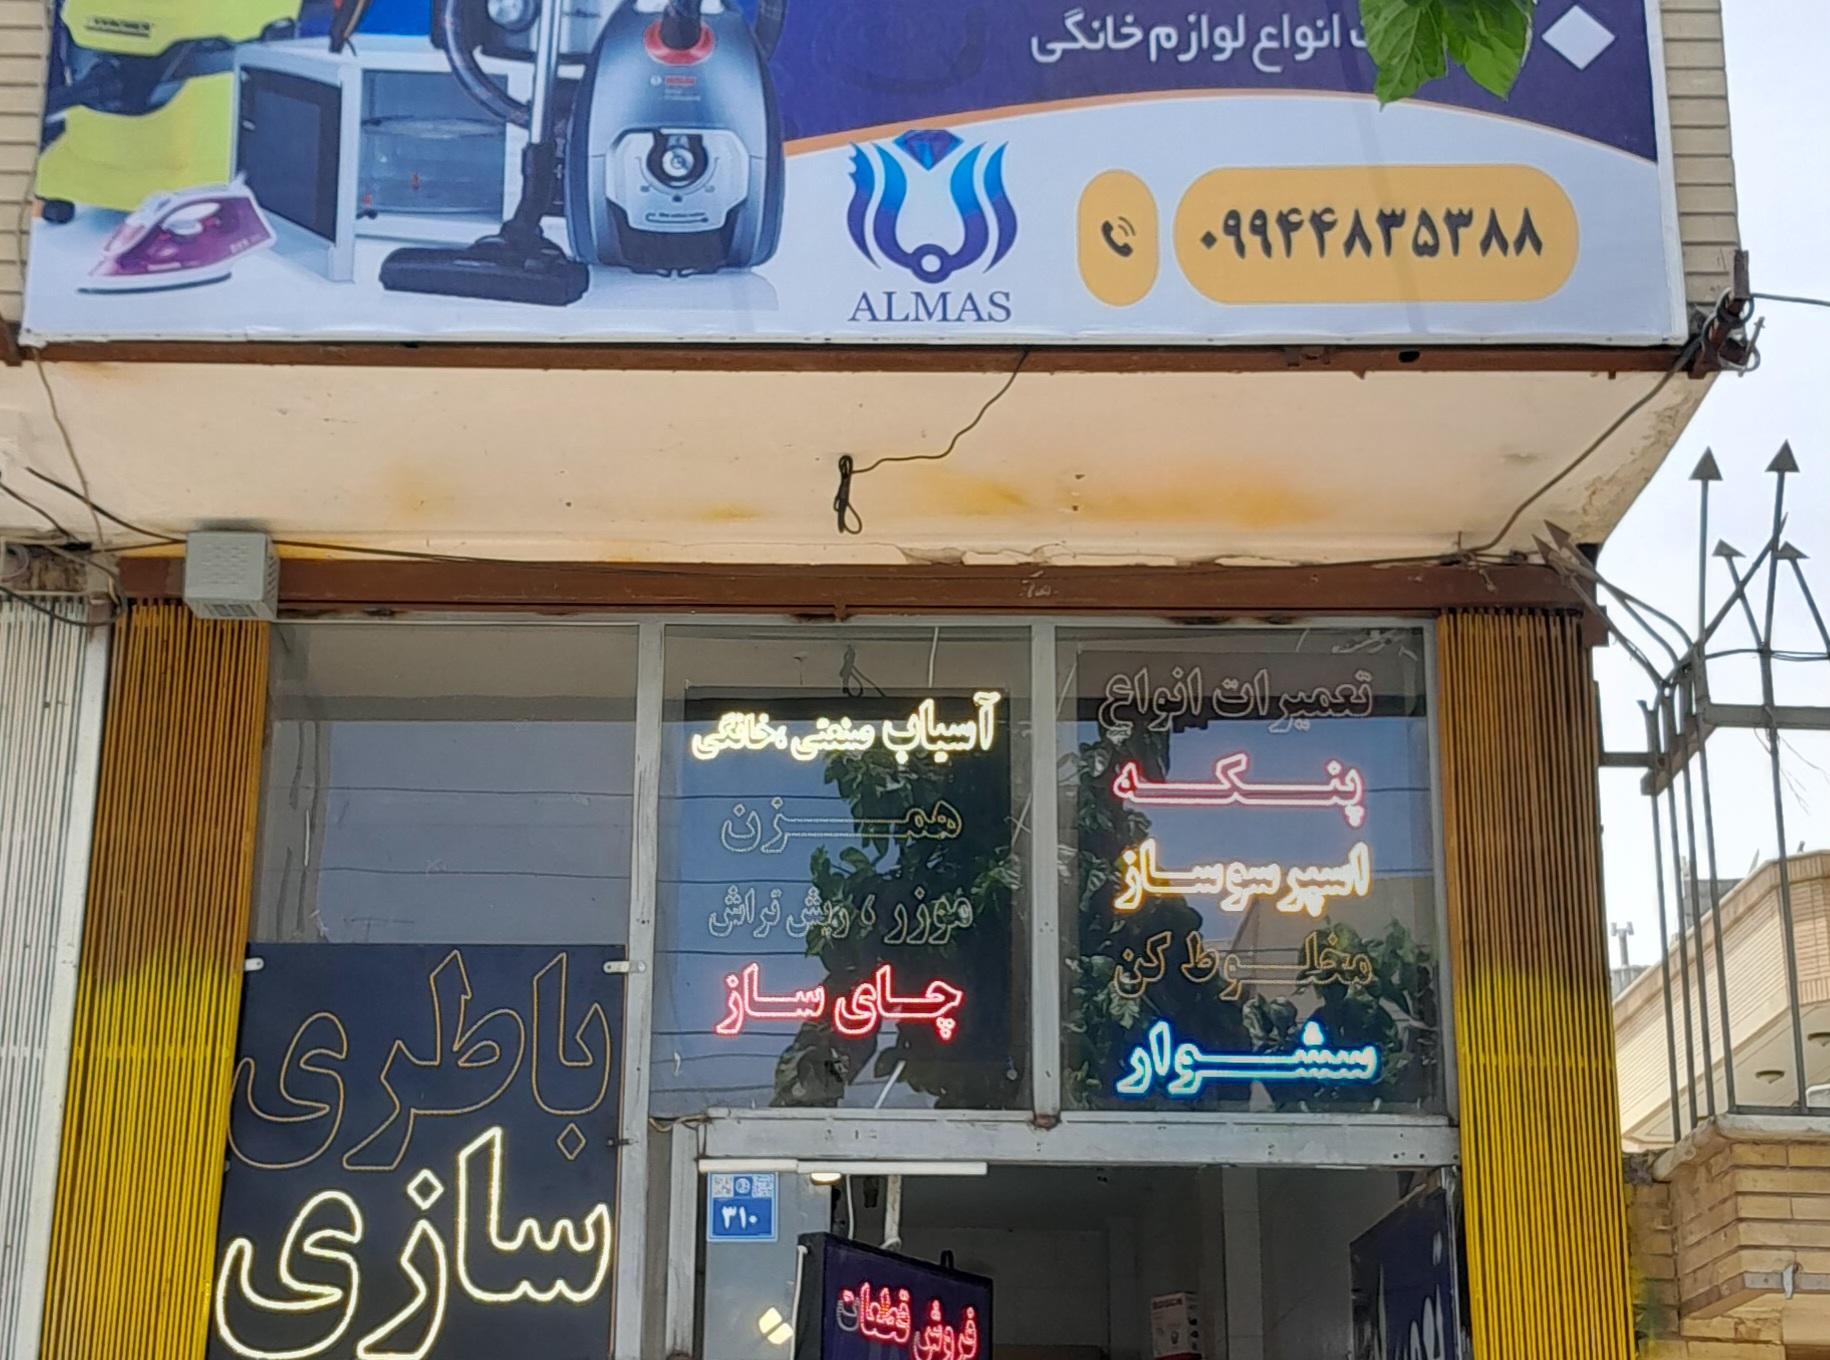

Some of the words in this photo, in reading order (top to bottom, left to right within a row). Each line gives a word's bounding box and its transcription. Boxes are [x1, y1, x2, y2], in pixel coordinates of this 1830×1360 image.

[1030, 10, 1143, 67] خانگی
[1149, 11, 1246, 67] لوازم
[1252, 12, 1341, 73] انواع
[1201, 206, 1543, 261] ۰۹۹۴۴۸۳۵۳۸۸
[848, 290, 1012, 323] ALMAS
[881, 691, 1001, 765] آسیاب
[1098, 666, 1202, 732] انواع
[1213, 668, 1374, 734] تعمیرات
[789, 717, 876, 761] صنعتی
[1112, 751, 1365, 828] پنکه
[721, 797, 963, 854] همزن
[708, 885, 782, 937] تراش
[786, 886, 850, 938] ریش
[883, 886, 974, 945] موزر
[1114, 931, 1172, 999] کن
[1180, 931, 1374, 1002] مخلوط
[713, 960, 827, 1036] ساز
[833, 962, 964, 1040] چای
[227, 949, 611, 1171] باطری
[1115, 1020, 1378, 1095] سشوار
[721, 1205, 759, 1230] ۳۱۰
[836, 1280, 911, 1343] قطعات
